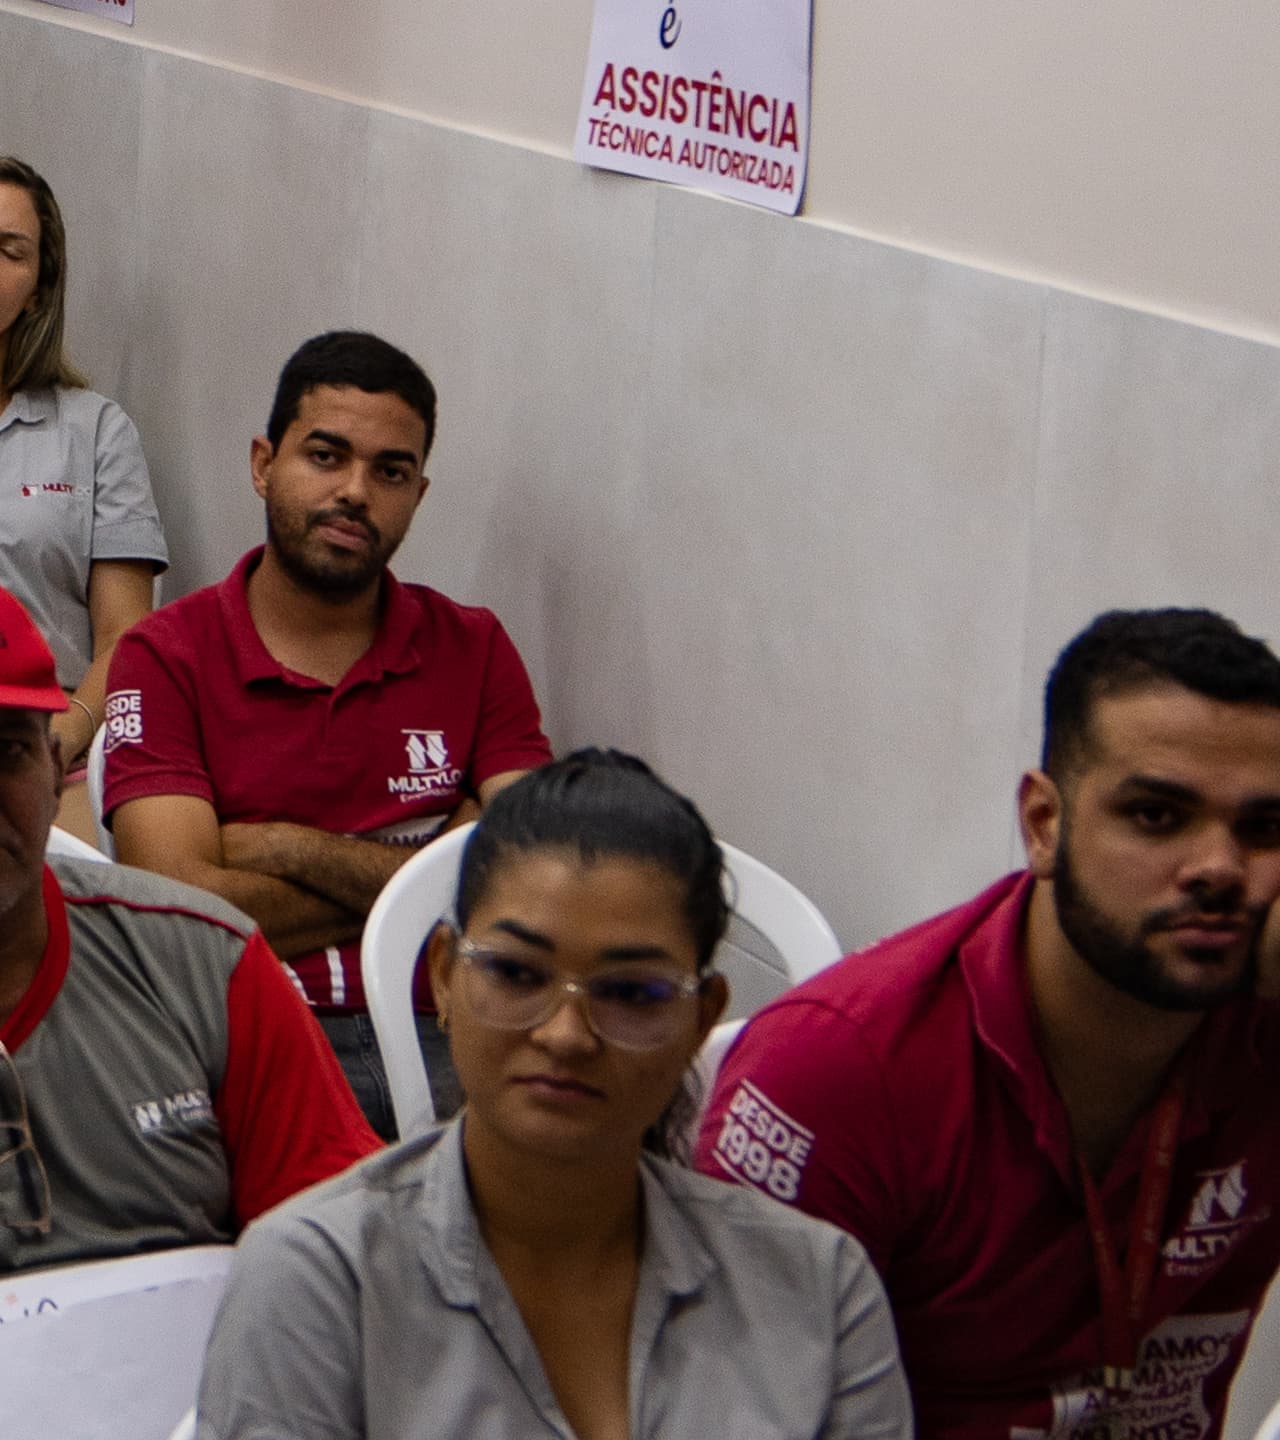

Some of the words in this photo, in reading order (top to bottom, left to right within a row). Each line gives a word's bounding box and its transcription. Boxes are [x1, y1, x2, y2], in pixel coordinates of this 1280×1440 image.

[593, 62, 800, 153] ASSISTÊNCIA
[588, 112, 673, 163] TÉCNICA
[678, 138, 795, 195] AUTORIZADA
[387, 768, 462, 793] MULTYLO
[717, 1112, 801, 1200] 1998
[729, 1088, 812, 1167] DESDE
